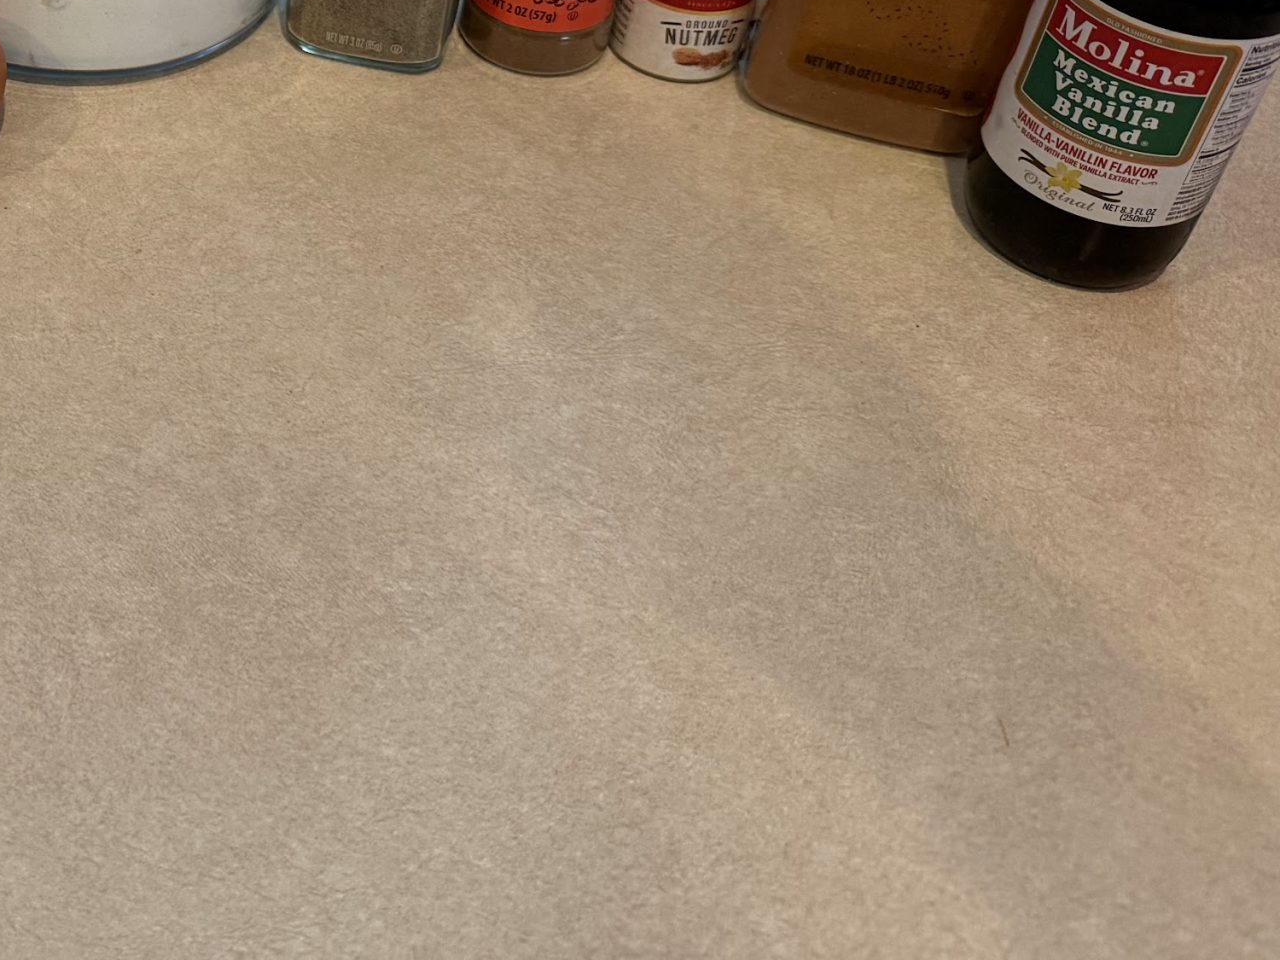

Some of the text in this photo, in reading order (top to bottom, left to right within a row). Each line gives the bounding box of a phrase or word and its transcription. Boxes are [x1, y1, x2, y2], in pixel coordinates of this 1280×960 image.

[506, 3, 513, 14] 2
[514, 6, 528, 17] OZ
[529, 9, 557, 24] (57g)
[685, 19, 729, 29] GROUND
[1106, 17, 1164, 44] OLD FASHIONED
[338, 33, 349, 45] WT
[355, 38, 365, 48] OZ
[664, 26, 738, 47] NUTMEG
[1055, 4, 1196, 88] Molina
[804, 53, 826, 68] NET
[825, 58, 842, 73] WT
[843, 64, 856, 76] 18
[856, 67, 872, 80] OZ
[871, 70, 882, 82] (1
[883, 73, 898, 86] LB
[906, 79, 925, 93] OZ)
[1052, 48, 1176, 114] Mexican
[1055, 69, 1160, 130] Vanilla
[1051, 93, 1143, 146] Blend
[1051, 120, 1095, 146] ESTABLISHED
[1094, 142, 1103, 150] IN
[1017, 107, 1108, 169] VANILLA-VANILLIN
[1108, 160, 1159, 179] FLAVOR
[1020, 125, 1141, 186] BLENDED WITH PURE VANILLA EXTRACT
[1023, 168, 1096, 212] Original
[1102, 202, 1158, 216] NET 8.3 FL OZ
[1119, 213, 1155, 224] (250mL)
